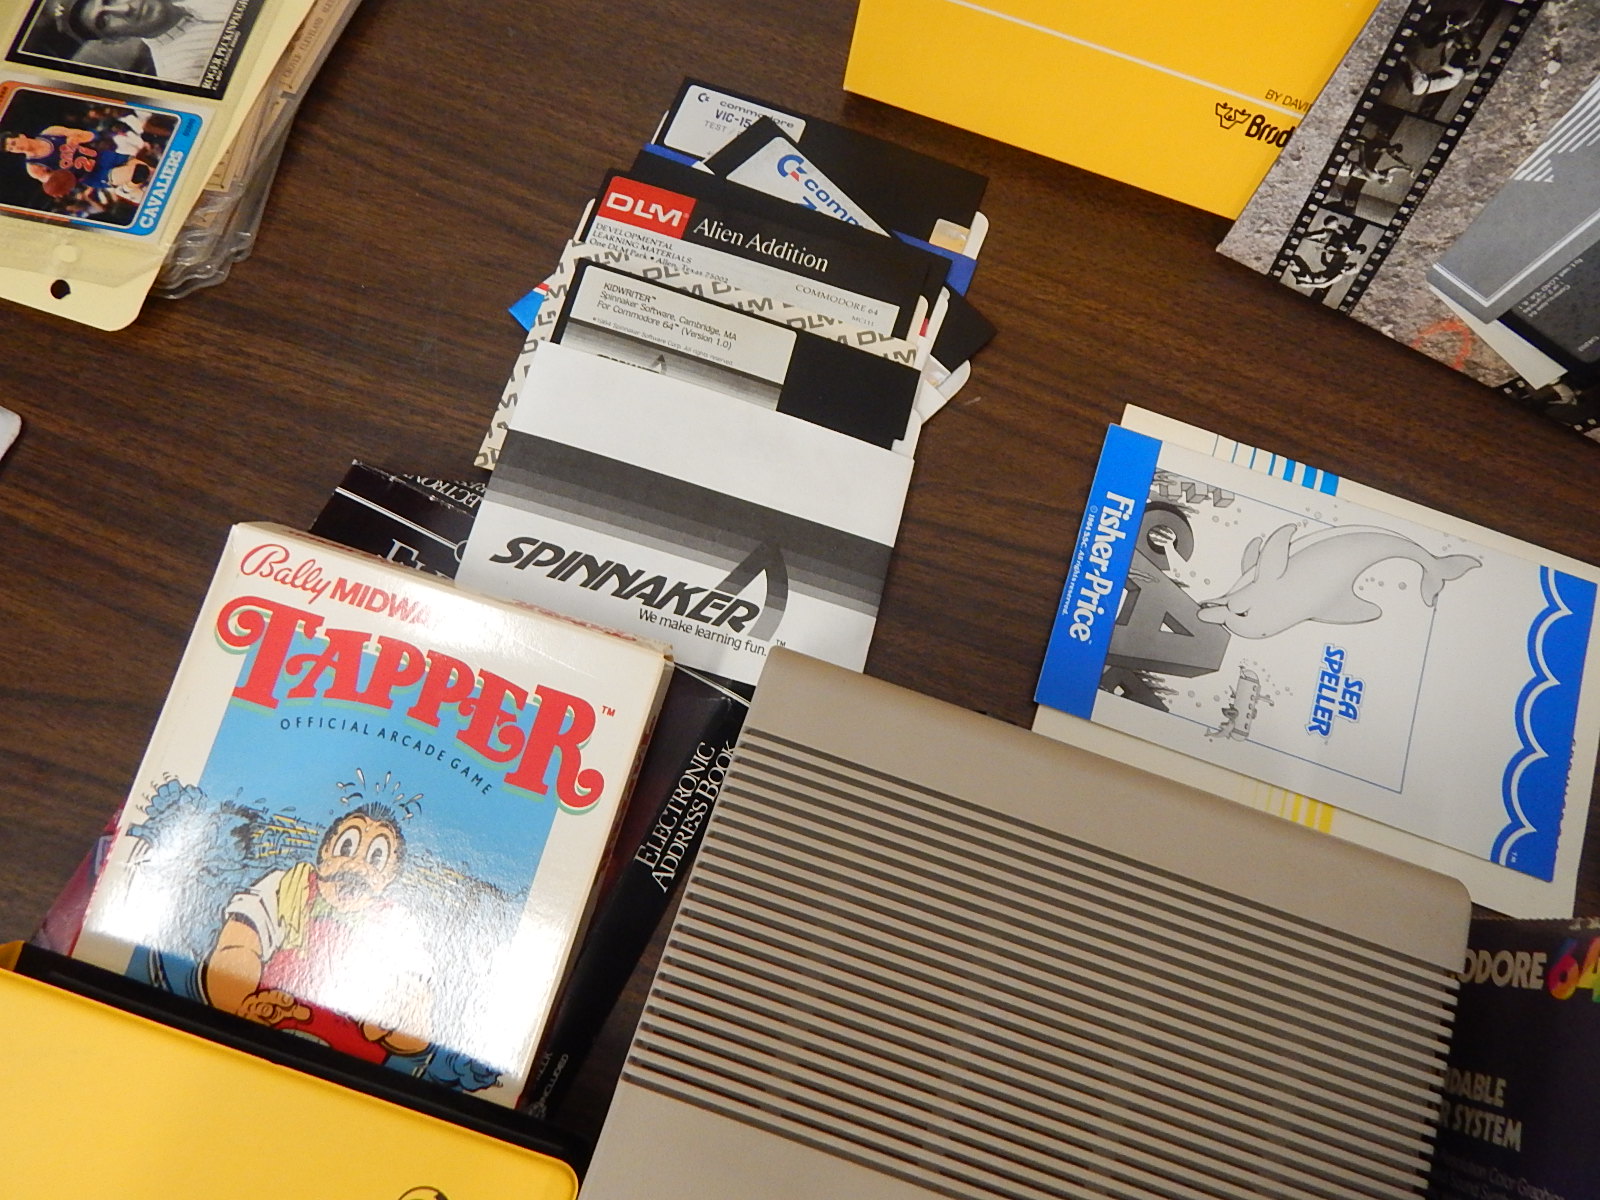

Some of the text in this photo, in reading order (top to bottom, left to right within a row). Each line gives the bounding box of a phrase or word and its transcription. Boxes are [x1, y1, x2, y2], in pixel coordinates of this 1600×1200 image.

[1264, 88, 1313, 113] BY DAVI
[703, 120, 727, 132] TEST
[137, 147, 186, 230] CAVALIERS
[606, 193, 682, 226] DLM
[589, 237, 606, 249] One
[606, 241, 628, 255] DLM
[628, 247, 648, 260] Park
[592, 231, 693, 265] LEARNING MATERIALS
[595, 222, 673, 250] DEVELOPMENTAL
[693, 217, 830, 272] Alien Addition
[599, 290, 738, 341] Spinnaker Software, Cambridge, MA
[795, 284, 879, 316] COMMODORE 64
[596, 300, 610, 311] For
[612, 303, 661, 326] Commodore
[680, 325, 716, 347] (Version
[718, 337, 733, 351] 1.0)
[640, 331, 666, 344] Software
[240, 543, 331, 604] Bally
[1069, 491, 1135, 642] Fisher-Price
[1069, 559, 1082, 581] rights
[1076, 549, 1084, 560] All
[490, 536, 760, 632] SPINNAKER
[637, 607, 658, 623] We
[658, 614, 693, 635] make
[693, 624, 742, 651] learning
[743, 639, 769, 657] fun.
[215, 595, 605, 812] TAPPER
[1307, 644, 1345, 738] SPELLER
[1338, 676, 1364, 722] SEA
[280, 715, 494, 796] OFFICIAL ARCADE GAME
[634, 741, 716, 870] ELECTRONIC
[651, 739, 735, 893] ADDRESS BOOK
[1457, 937, 1600, 1004] ODORE 64
[1453, 1103, 1523, 1152] SYSTEM
